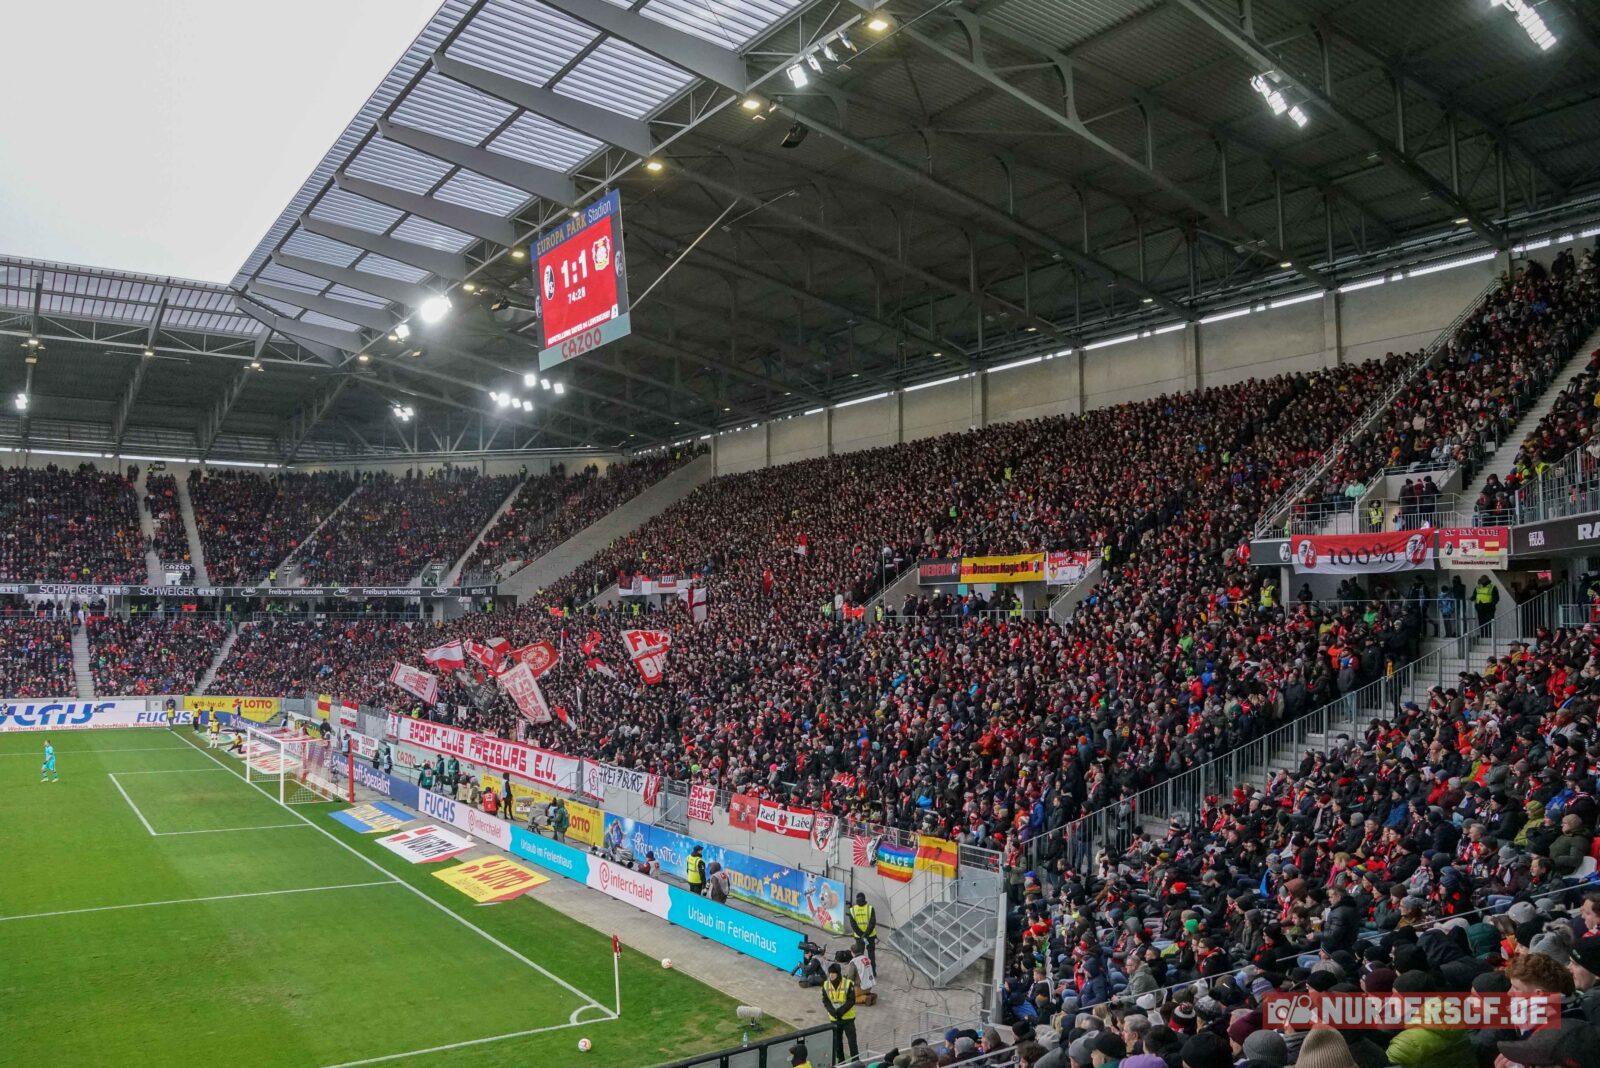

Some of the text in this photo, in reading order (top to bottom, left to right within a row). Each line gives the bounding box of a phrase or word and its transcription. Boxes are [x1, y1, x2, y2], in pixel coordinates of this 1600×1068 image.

[537, 200, 612, 256] EUROPA PARK Stadion
[561, 249, 588, 289] 1:1
[561, 328, 601, 359] CAZOO
[1328, 542, 1396, 566] 100%
[40, 585, 98, 595] SCHWEIGER
[140, 586, 195, 596] SCHWEIGER
[268, 588, 291, 597] Freiburg
[292, 588, 324, 596] verbunden
[363, 588, 388, 597] Freiburg
[388, 588, 421, 596] verbunden
[244, 699, 272, 709] LOTTO
[409, 720, 465, 755] SPORT-CLUB
[332, 755, 391, 796] Schmietoff-Spezialist
[691, 785, 716, 802] 50+1
[424, 792, 456, 823] FUCHS
[760, 807, 776, 822] Red
[884, 853, 909, 868] PACE
[605, 871, 653, 902] interchalet
[771, 882, 801, 907] PARK
[688, 905, 777, 954] Urlaub im Ferienhaus
